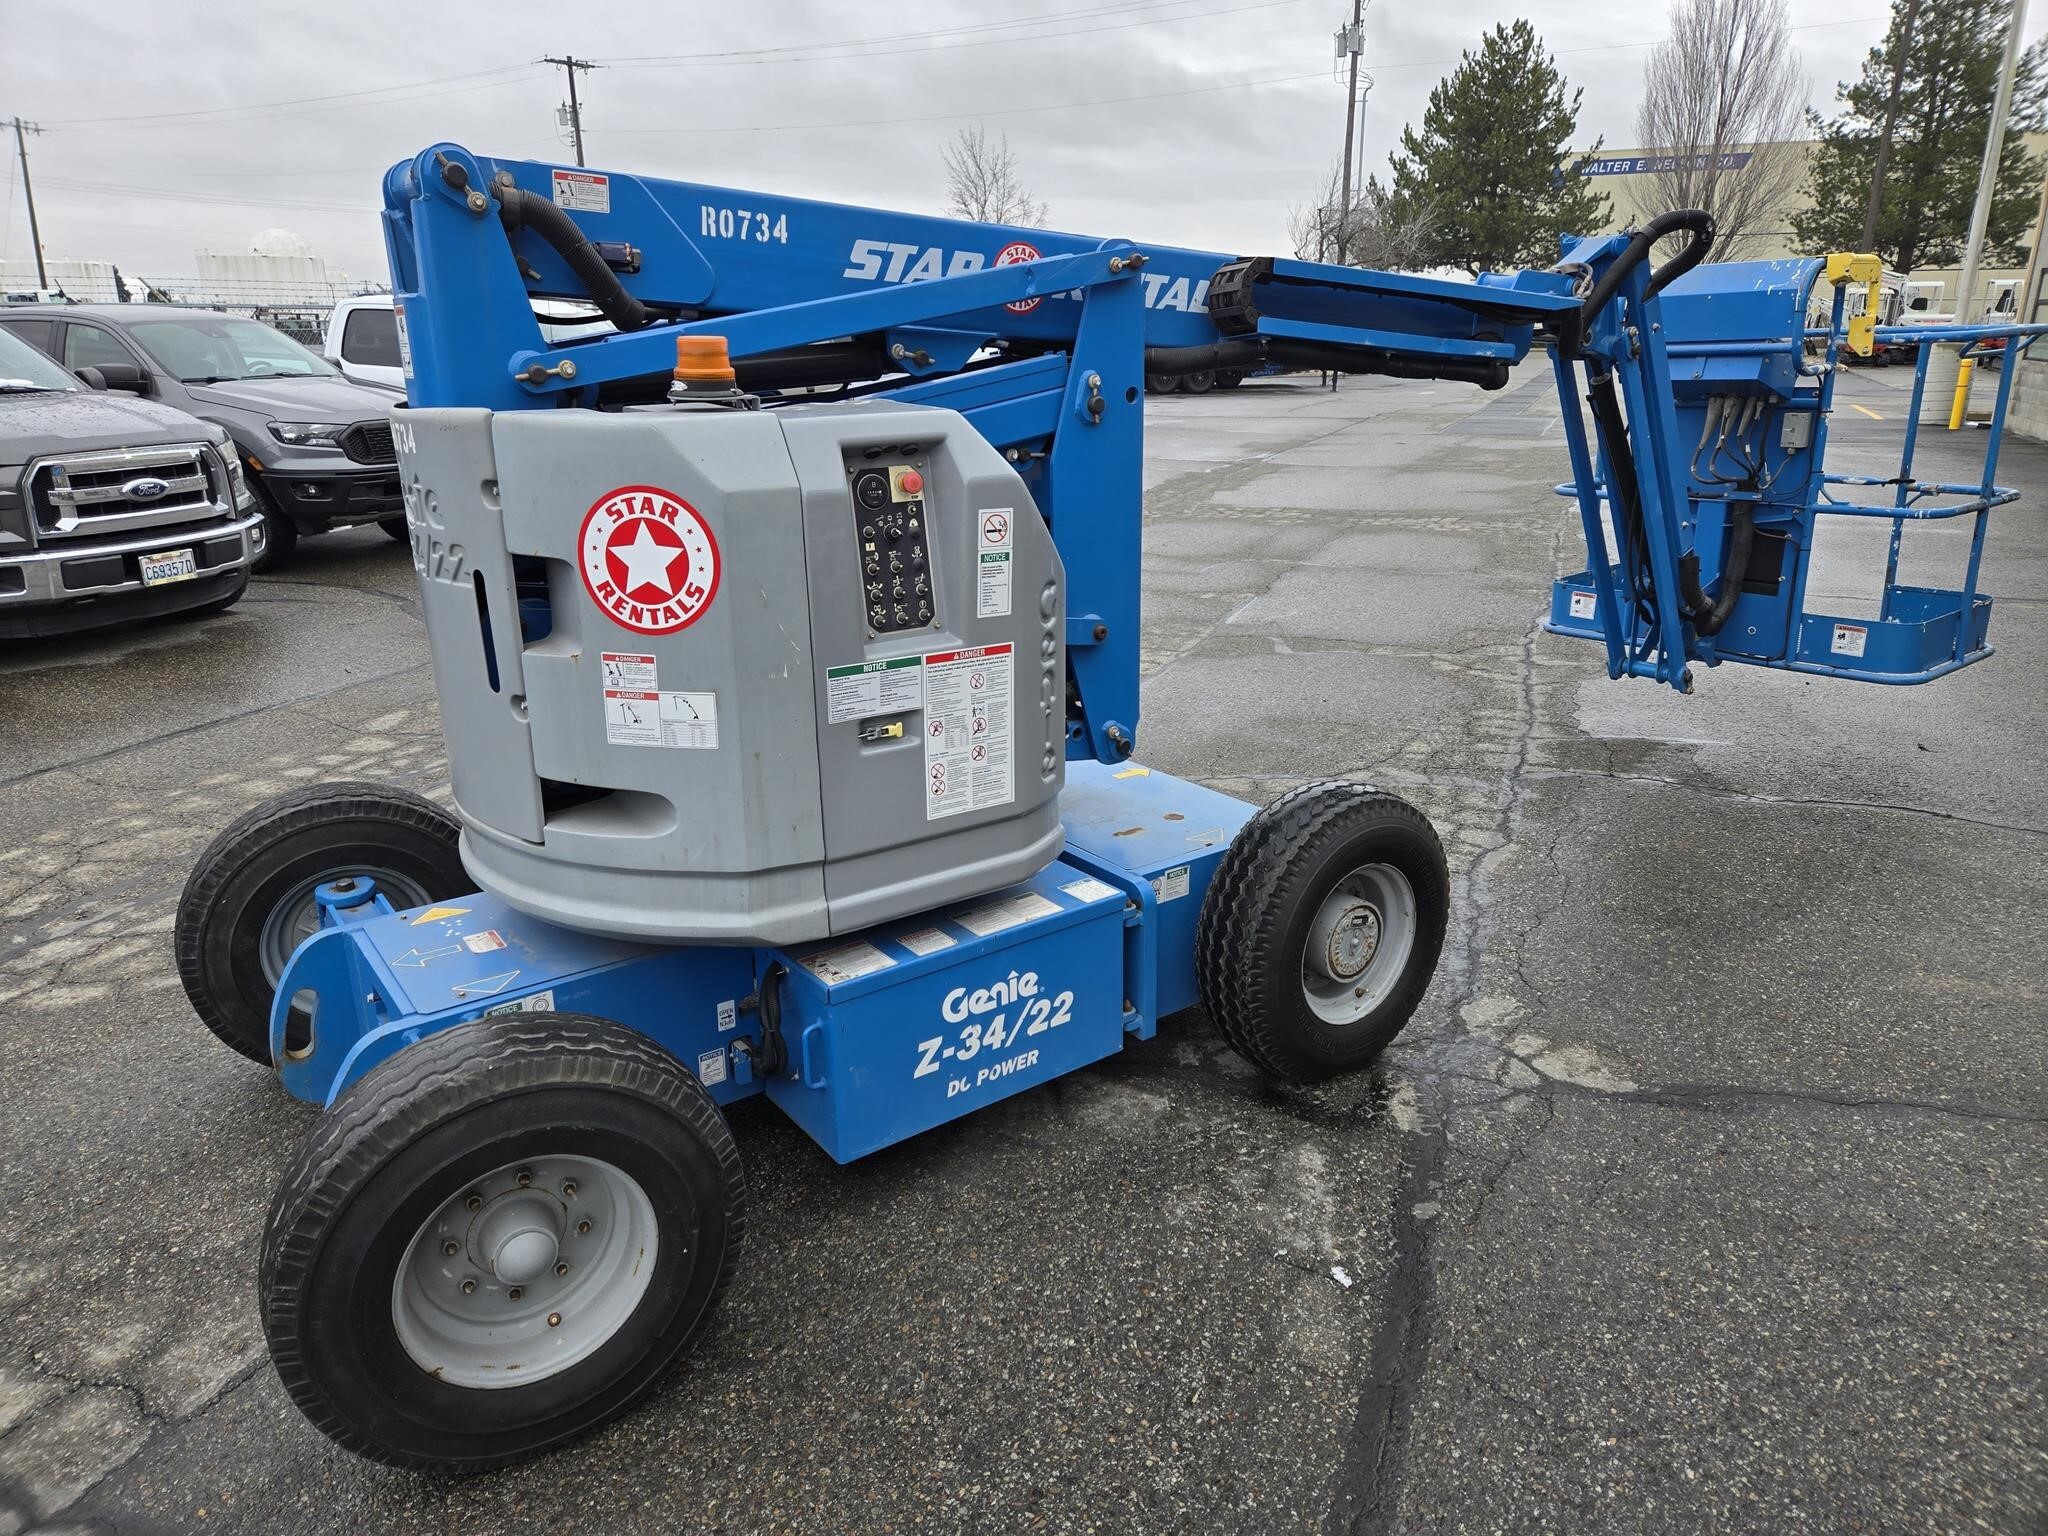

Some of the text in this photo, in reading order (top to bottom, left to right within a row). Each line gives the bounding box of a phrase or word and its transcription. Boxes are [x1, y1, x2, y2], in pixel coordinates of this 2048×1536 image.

[1636, 160, 1647, 171] E.
[572, 175, 594, 183] DANGER
[701, 205, 788, 244] R0734
[1006, 246, 1036, 261] STAR
[138, 483, 161, 496] Ford
[604, 496, 680, 527] STAR
[983, 553, 1006, 563] NOTICE
[145, 559, 193, 581] C69357D
[595, 580, 706, 626] RENTALS
[959, 648, 986, 660] DANGER
[863, 661, 888, 674] NOTICE
[621, 691, 645, 699] DANGER
[1169, 869, 1185, 878] NOTICE
[941, 969, 1039, 1024] Genie
[491, 1004, 518, 1018] NOTICE
[718, 1007, 734, 1017] OPEN
[719, 1018, 735, 1028] OPEN
[913, 990, 1075, 1080] Z-34/22
[701, 1051, 722, 1062] NOTICE
[946, 1049, 1040, 1098] DC POWER
